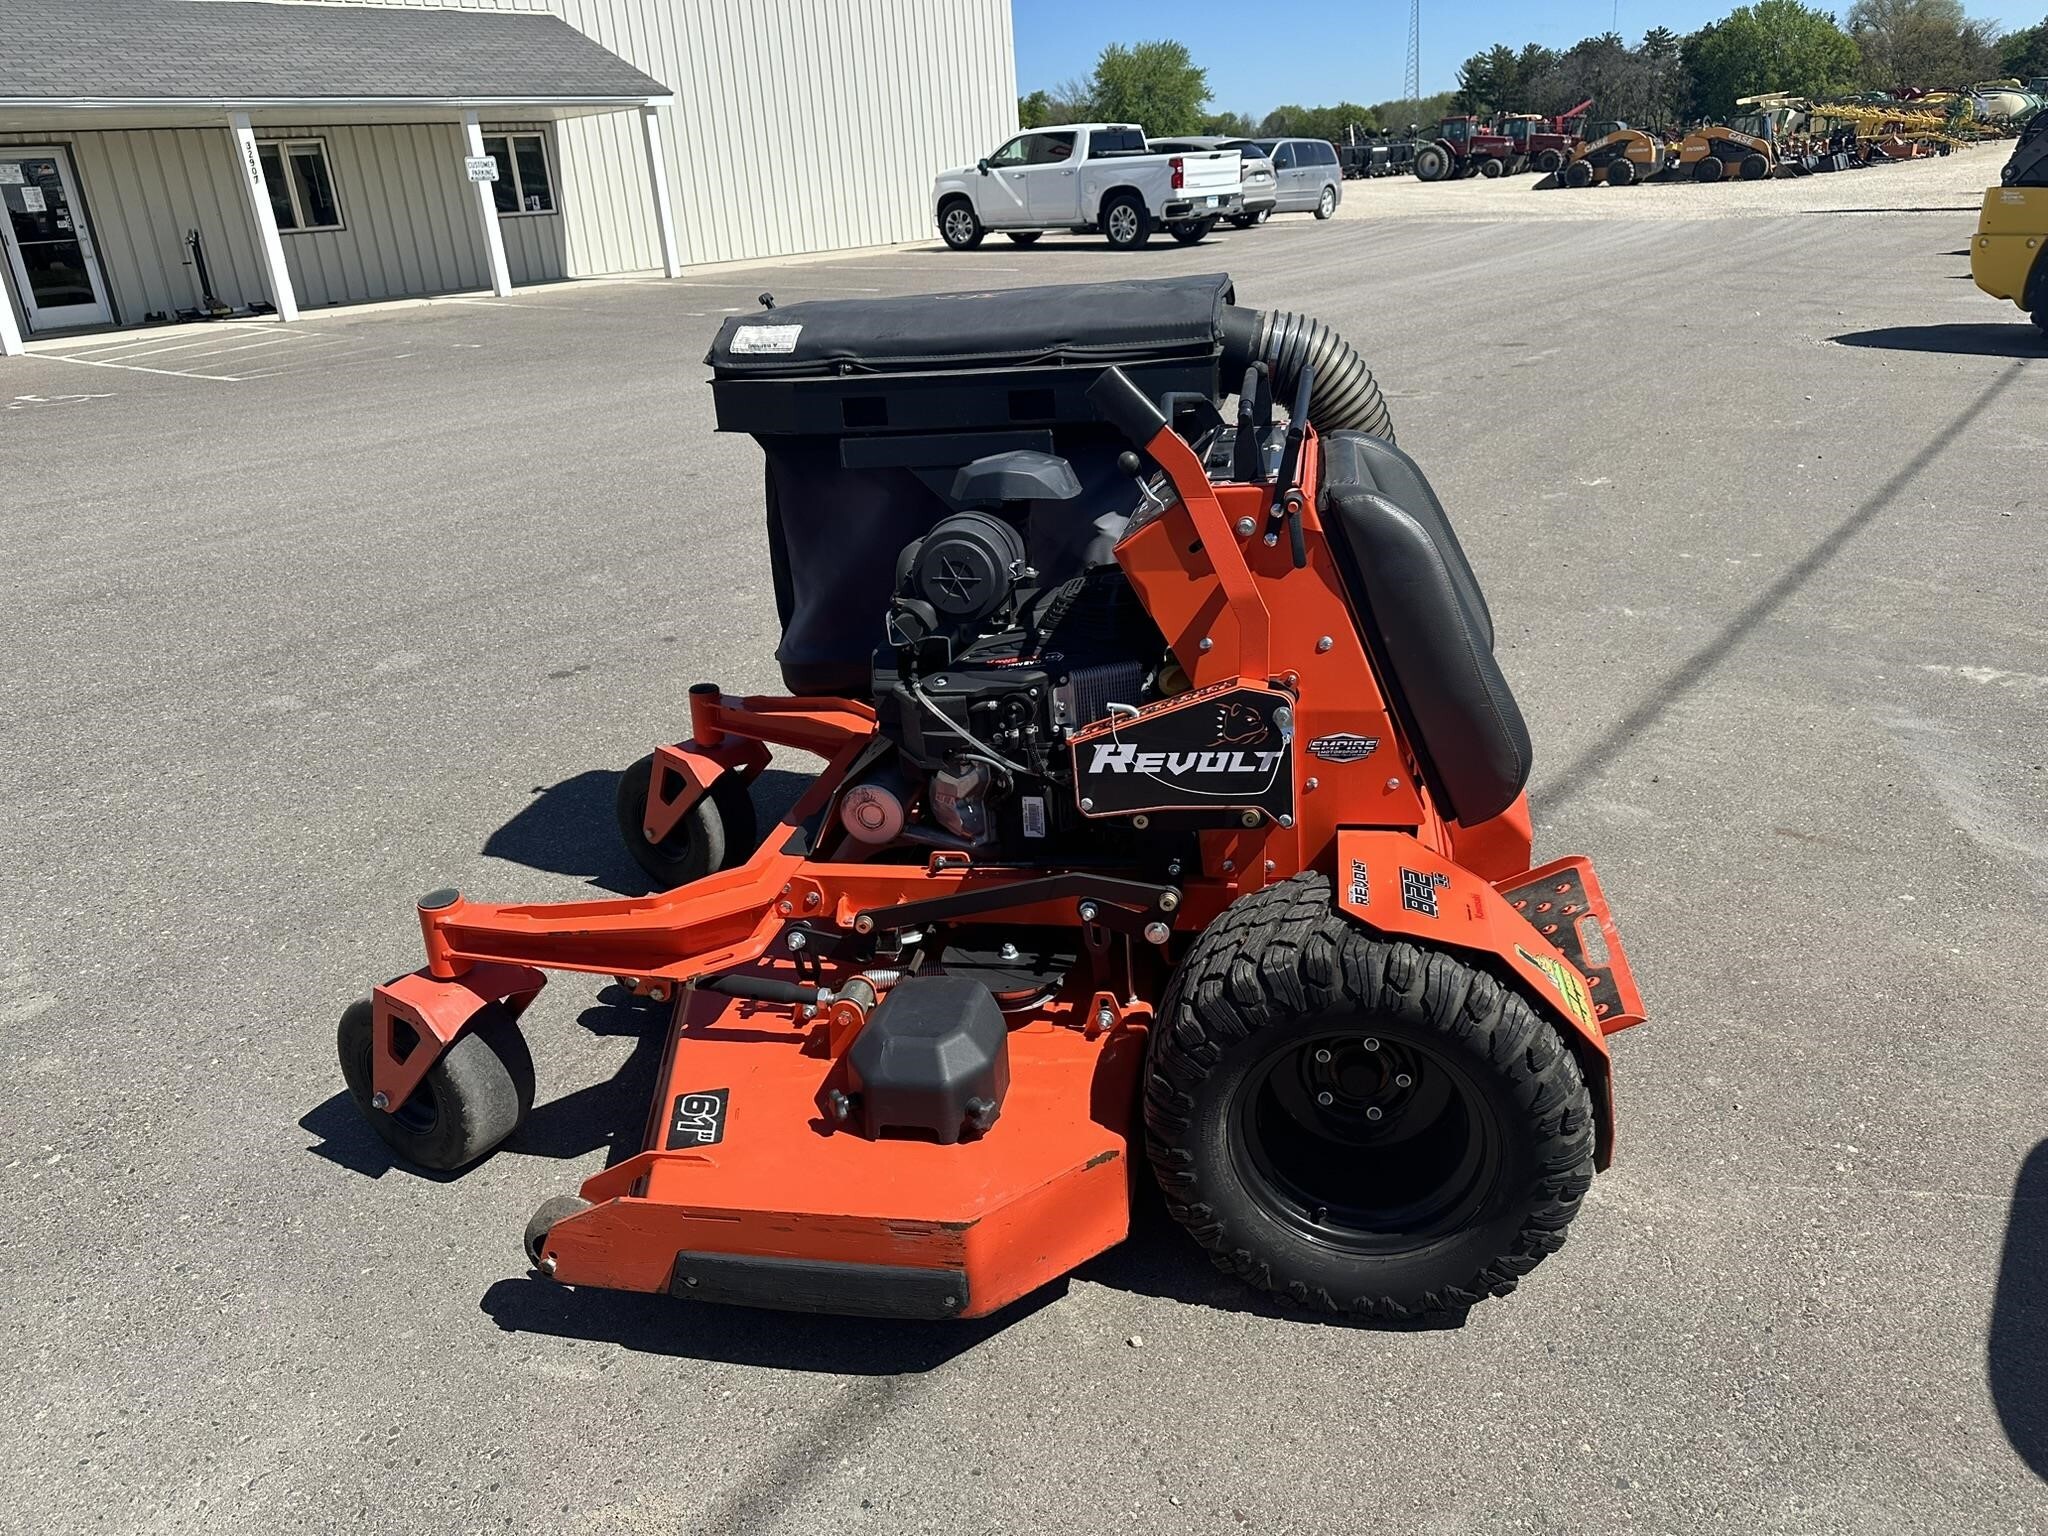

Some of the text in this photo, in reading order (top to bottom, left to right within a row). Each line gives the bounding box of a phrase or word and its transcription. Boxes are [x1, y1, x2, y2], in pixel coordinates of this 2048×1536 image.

[1584, 135, 1609, 153] CASE
[1728, 132, 1753, 146] CASE
[245, 141, 259, 184] 32907
[468, 161, 495, 169] CUSTOMER
[1310, 740, 1377, 750] EMPIRE
[1088, 744, 1284, 776] REVOLT
[1352, 859, 1369, 906] REVOLT
